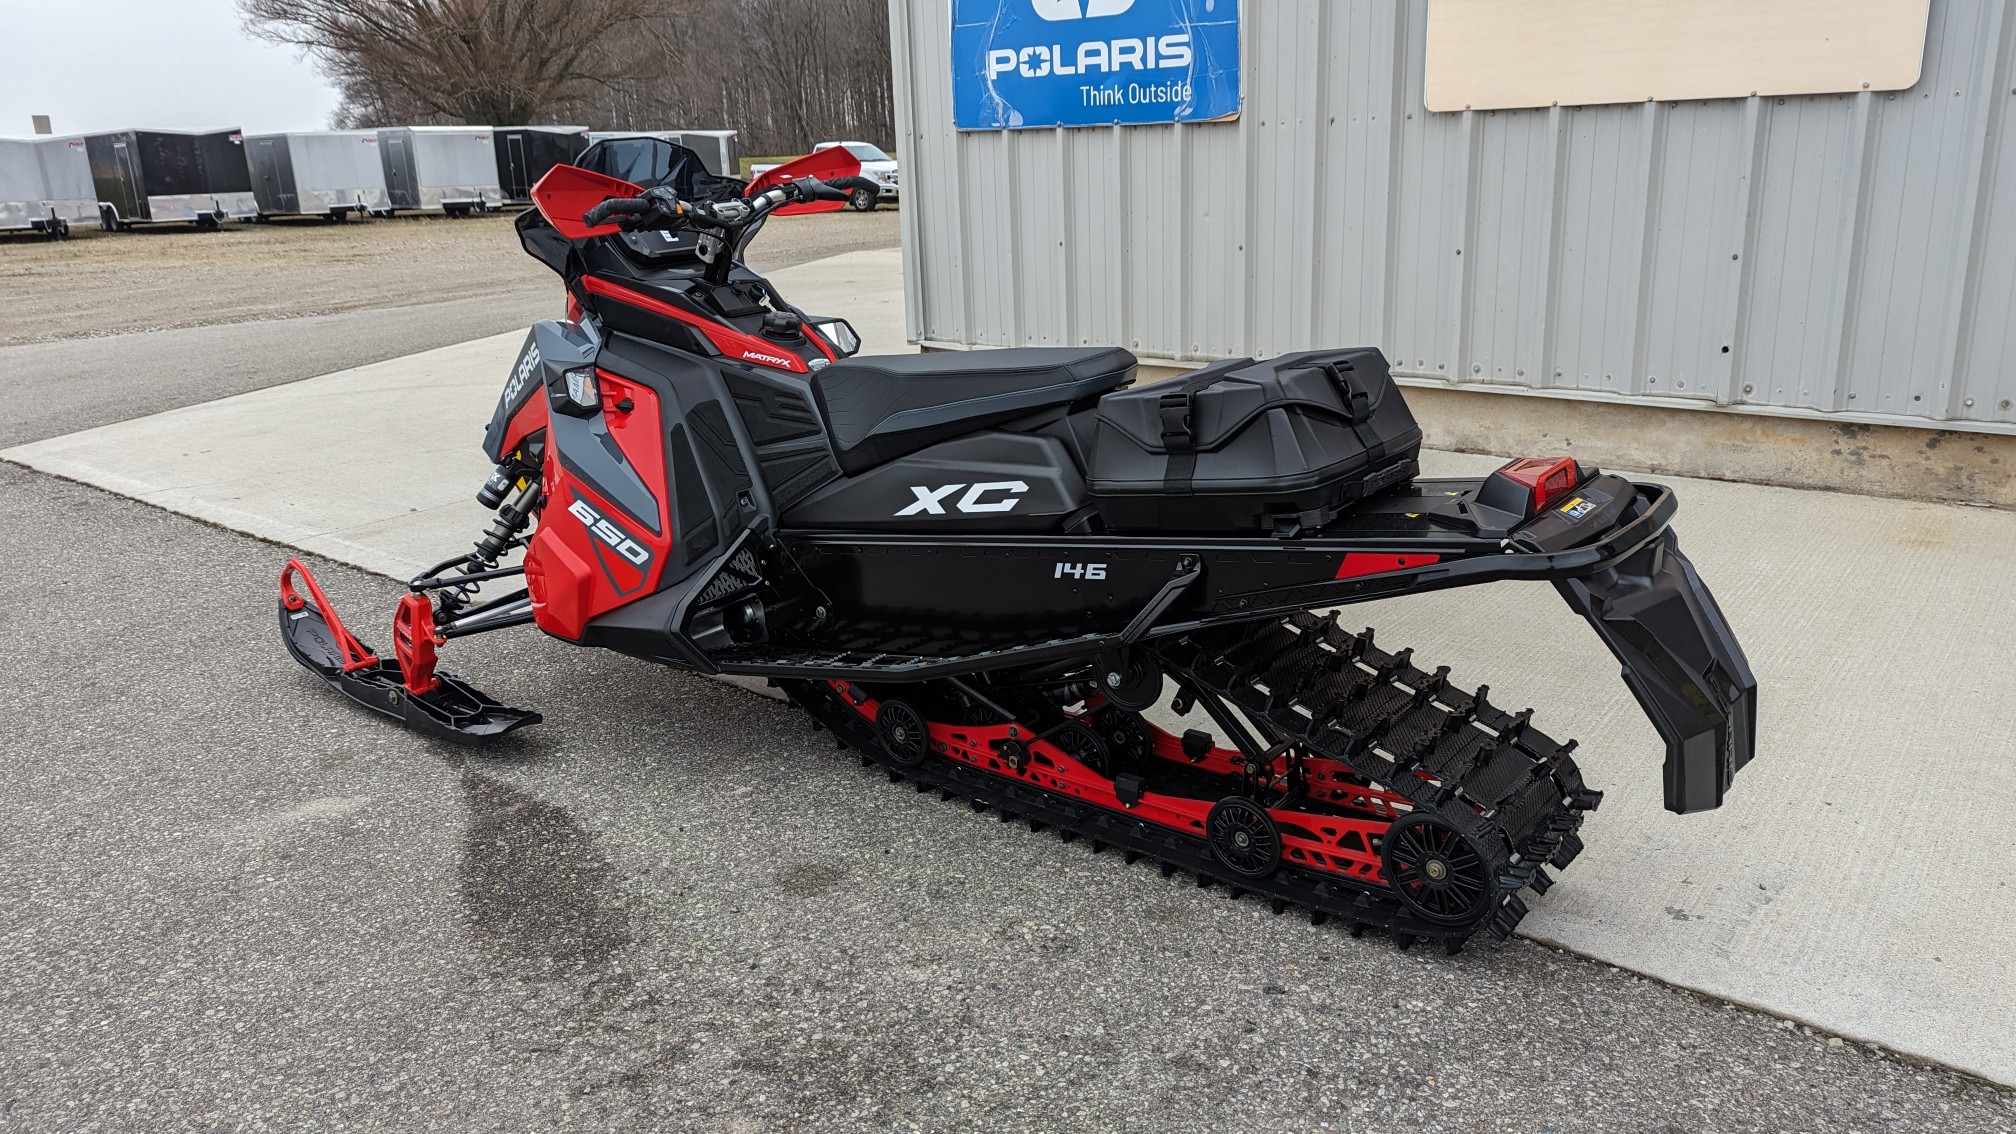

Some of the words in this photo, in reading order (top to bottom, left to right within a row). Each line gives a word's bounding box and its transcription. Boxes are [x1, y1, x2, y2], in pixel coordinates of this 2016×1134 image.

[987, 34, 1193, 80] POLARIS
[1080, 84, 1124, 107] Think
[1129, 81, 1192, 105] Outside
[504, 341, 541, 409] POLARIS
[742, 350, 792, 368] MATRYX
[893, 480, 1030, 517] XC
[567, 498, 649, 566] 650
[1053, 562, 1107, 580] 146
